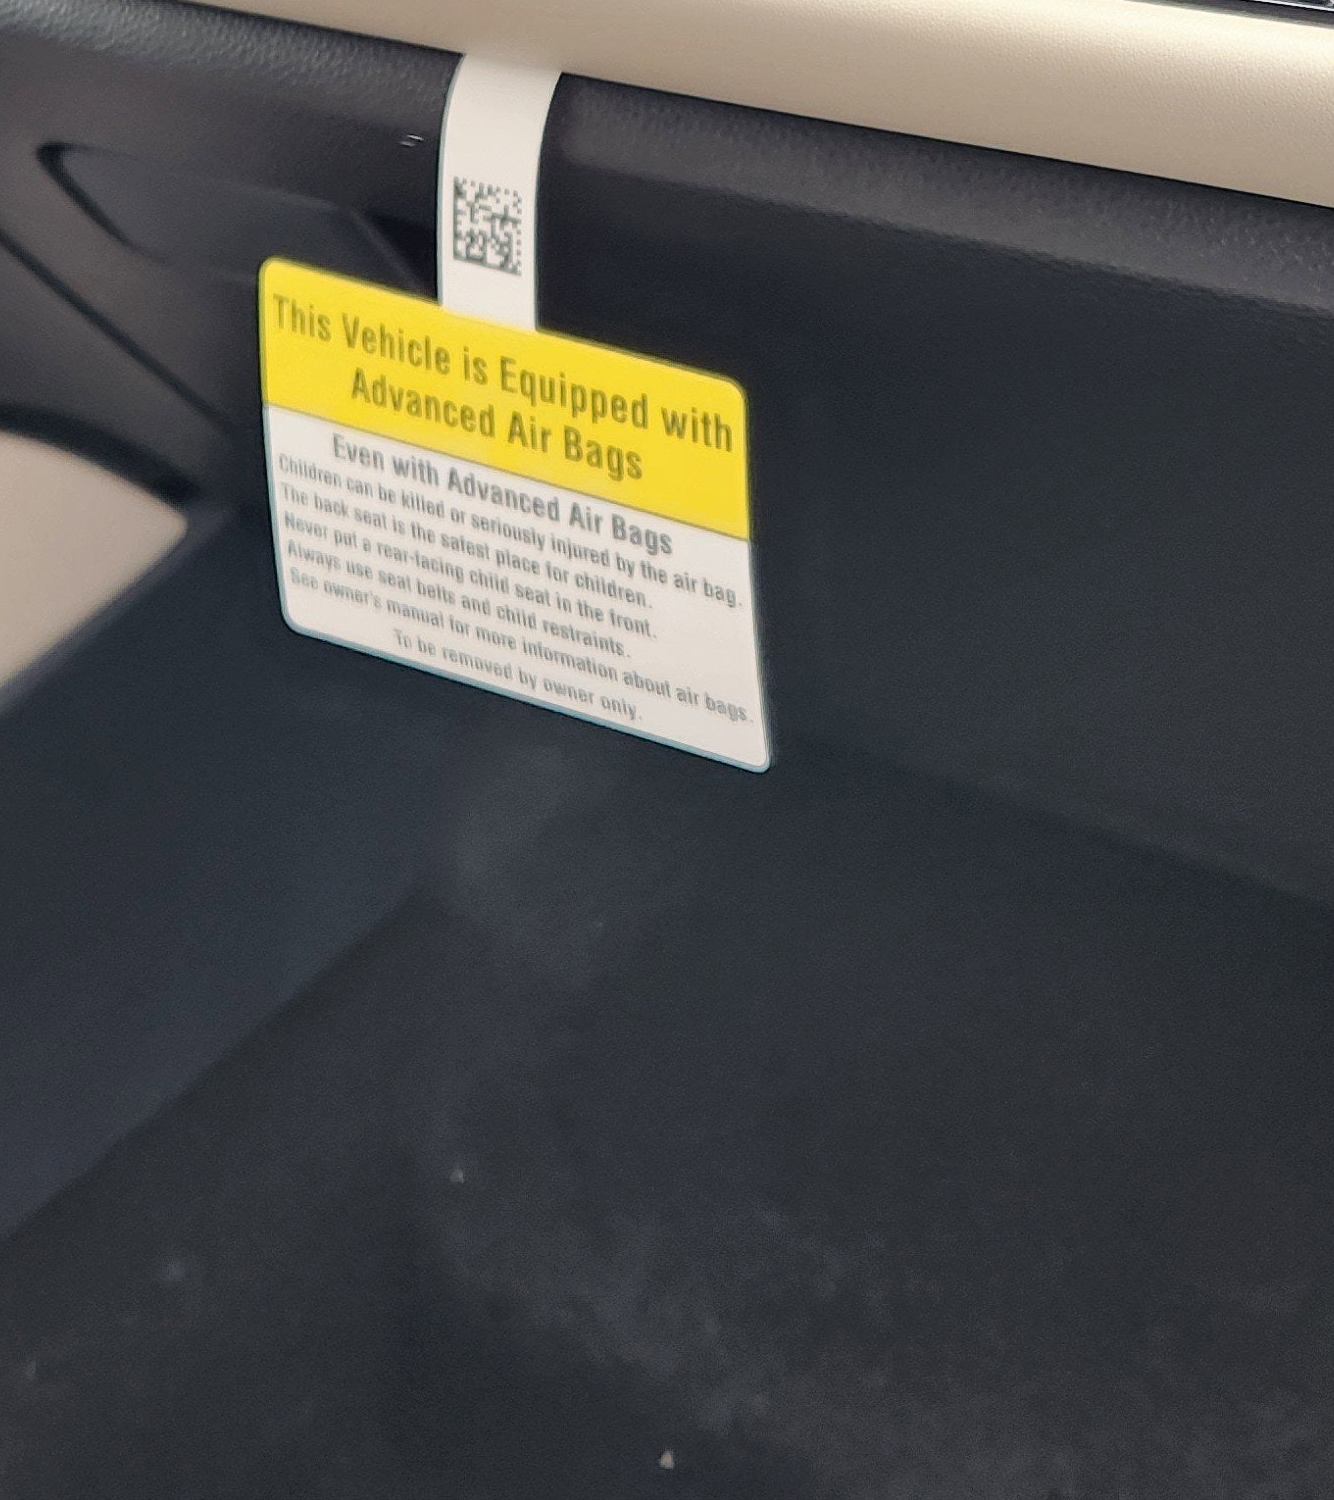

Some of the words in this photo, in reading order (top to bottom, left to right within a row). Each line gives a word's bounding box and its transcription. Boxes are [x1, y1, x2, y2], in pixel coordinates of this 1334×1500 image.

[272, 292, 331, 341] This
[341, 312, 450, 375] Vehicle
[463, 345, 488, 385] is
[499, 355, 648, 429] Equipped
[660, 407, 732, 452] with
[351, 367, 495, 437] Advanced
[507, 410, 551, 453] Air
[563, 424, 642, 481] Bags
[278, 452, 341, 487] Children
[346, 477, 373, 497] can
[378, 482, 395, 503] be
[401, 489, 444, 518] killed
[450, 507, 465, 524] or
[470, 513, 545, 551] seriously
[550, 537, 610, 567] injured
[615, 552, 634, 578] by
[639, 560, 667, 584] the
[673, 572, 697, 592] air
[280, 481, 308, 505] The
[313, 492, 348, 517] back
[354, 507, 387, 530] seat
[392, 514, 405, 535] is
[410, 521, 435, 543] the
[440, 533, 489, 559] safest
[495, 548, 540, 574] place
[545, 561, 569, 583] for
[332, 433, 384, 470] Even
[391, 455, 439, 486] with
[447, 467, 560, 521] Advanced
[568, 501, 602, 534] Air
[611, 513, 672, 556] Bags
[284, 510, 327, 538] Never
[333, 529, 357, 547] put
[362, 537, 371, 553] a
[376, 542, 464, 583] rear-facing
[469, 568, 509, 593] child
[514, 583, 550, 606] seat
[555, 591, 571, 613] in
[576, 599, 603, 622] the
[287, 538, 341, 571] Always
[345, 560, 373, 579] use
[378, 570, 411, 591] seat
[416, 578, 455, 604] belts
[461, 594, 490, 616] and
[496, 605, 536, 629] child
[289, 566, 318, 589] See
[323, 580, 381, 608] owner's
[386, 599, 444, 627] manual
[448, 614, 469, 635] for
[475, 626, 516, 650] more
[522, 639, 618, 681] information
[622, 670, 671, 698] about
[675, 686, 699, 706] air
[393, 628, 412, 648] To
[417, 636, 435, 655] be
[441, 647, 512, 679] removed
[518, 666, 536, 690] by
[542, 678, 593, 704] owner
